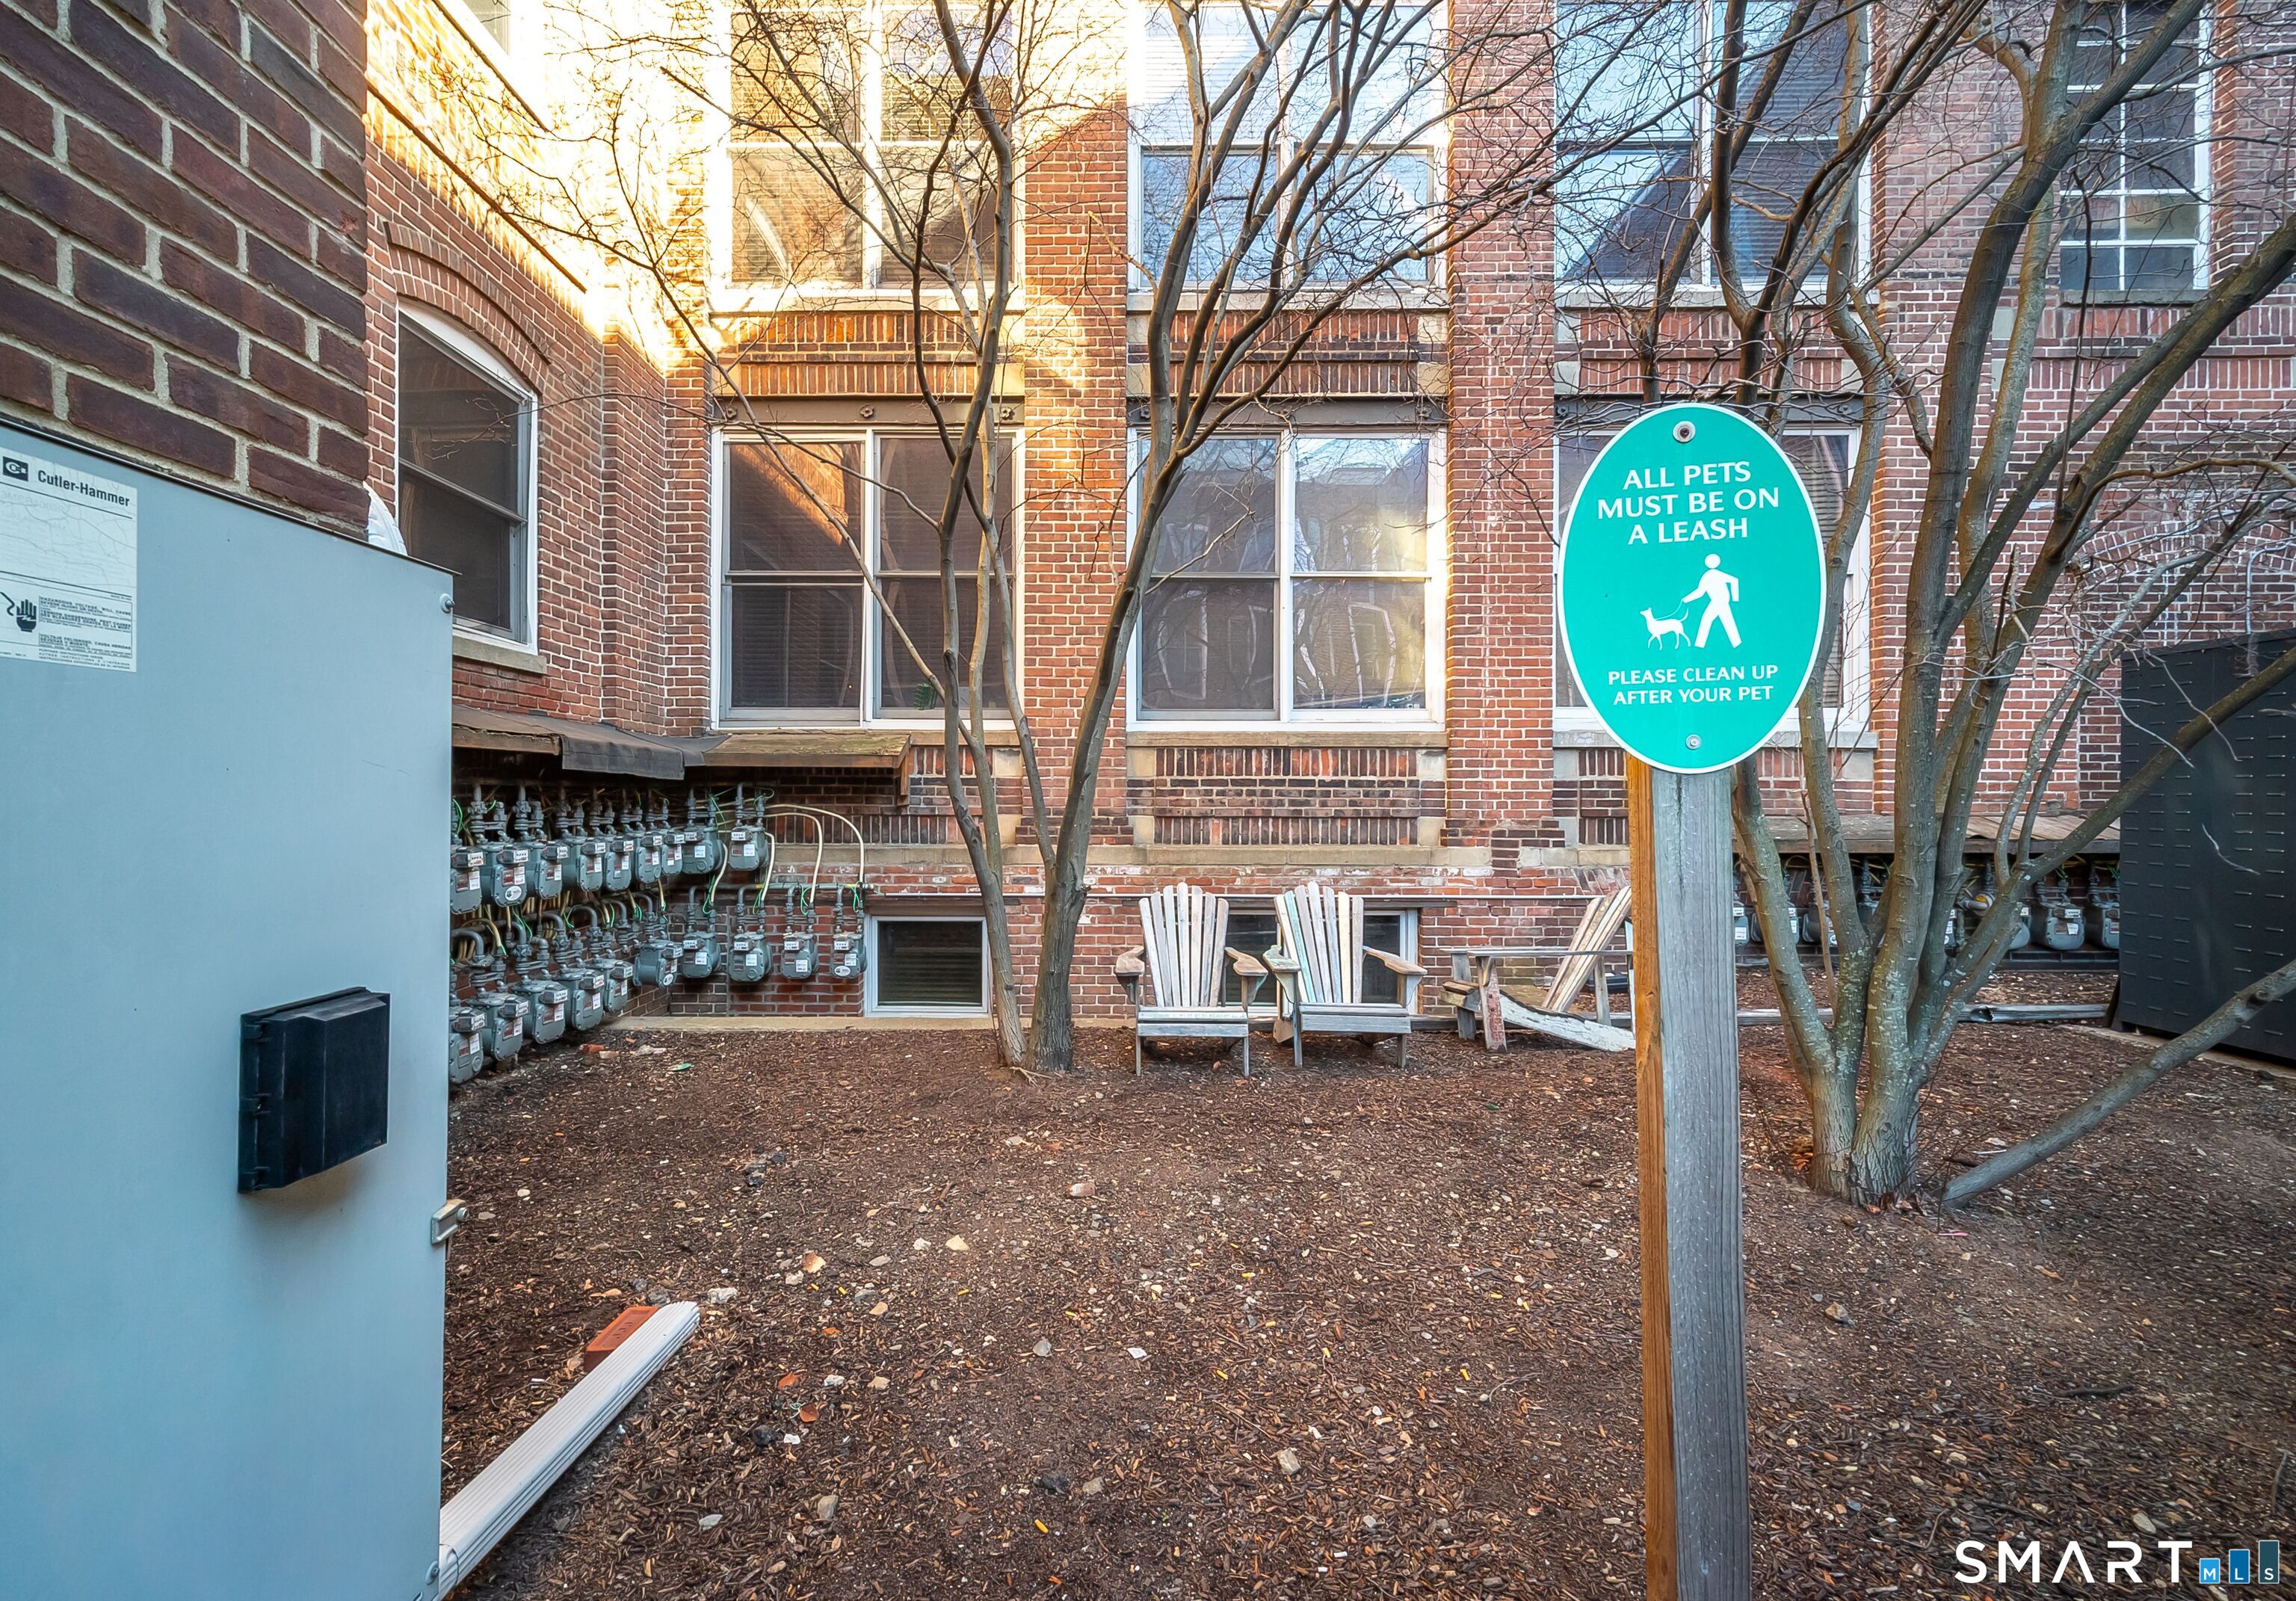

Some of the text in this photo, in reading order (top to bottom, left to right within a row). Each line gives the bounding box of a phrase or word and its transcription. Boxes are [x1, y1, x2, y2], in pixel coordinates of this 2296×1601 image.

[37, 469, 130, 507] Cutler-Hammer
[1623, 460, 1751, 490] ALL PETS
[1598, 487, 1779, 519] MUST BE ON
[1628, 517, 1747, 545] A LEASH
[1608, 664, 1778, 685] PLEASE CLEAN UP
[1614, 685, 1774, 705] AFTER YOUR PET
